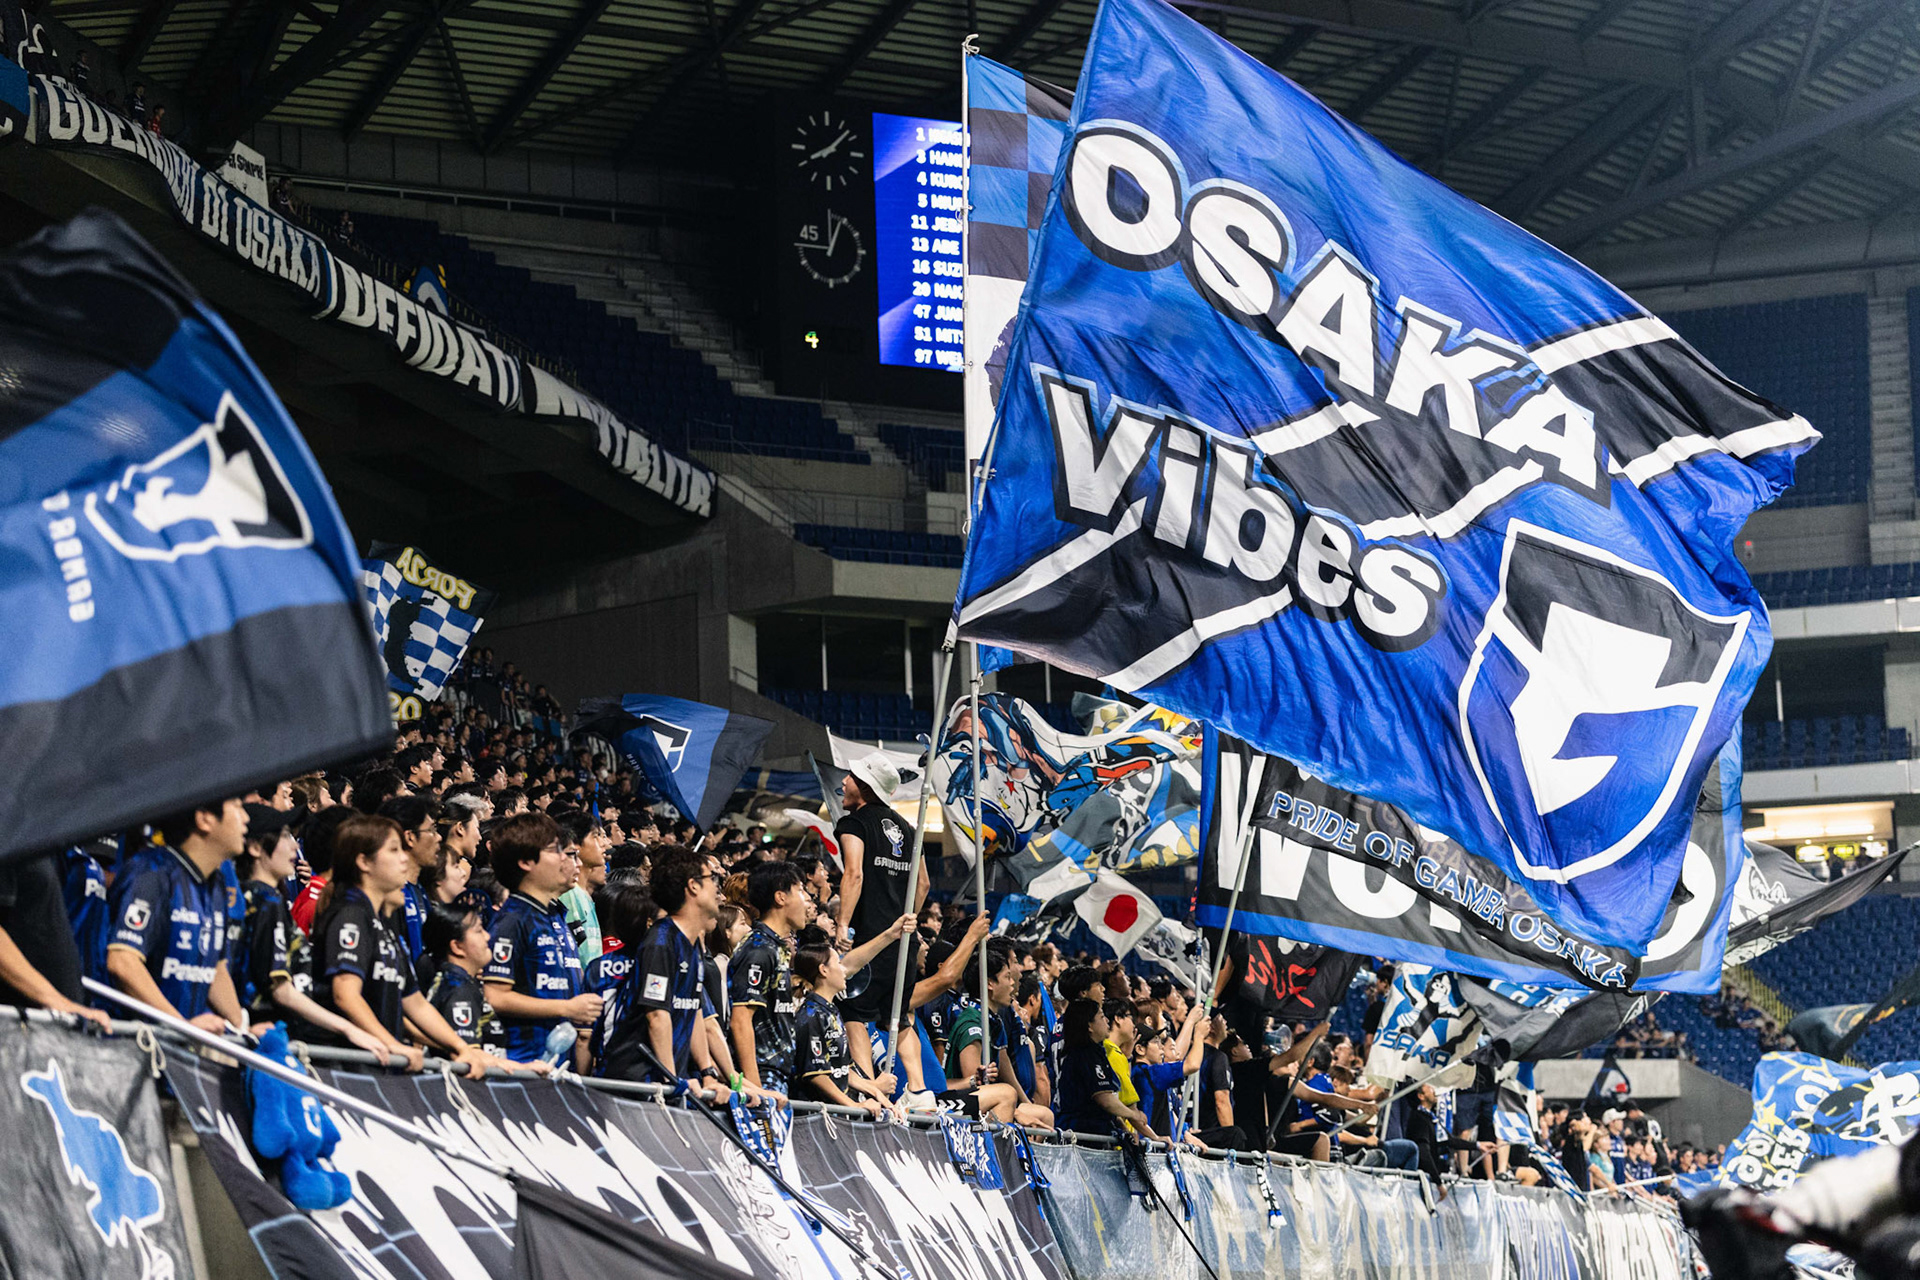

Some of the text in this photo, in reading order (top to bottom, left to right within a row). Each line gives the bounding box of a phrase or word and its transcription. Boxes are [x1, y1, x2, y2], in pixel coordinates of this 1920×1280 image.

[917, 171, 928, 186] 4
[911, 215, 929, 230] 11
[201, 172, 229, 246] DI
[233, 196, 321, 299] OSAKA
[800, 224, 819, 241] 45
[913, 304, 931, 319] 47
[1066, 125, 1604, 500] OSAKA
[914, 326, 932, 342] 51
[914, 348, 933, 364] 97
[1040, 372, 1447, 645] Vibes
[1267, 790, 1360, 854] PRIDE
[1364, 830, 1414, 868] OF
[1414, 855, 1507, 931] GAMBA
[1509, 913, 1627, 988] OSAKA
